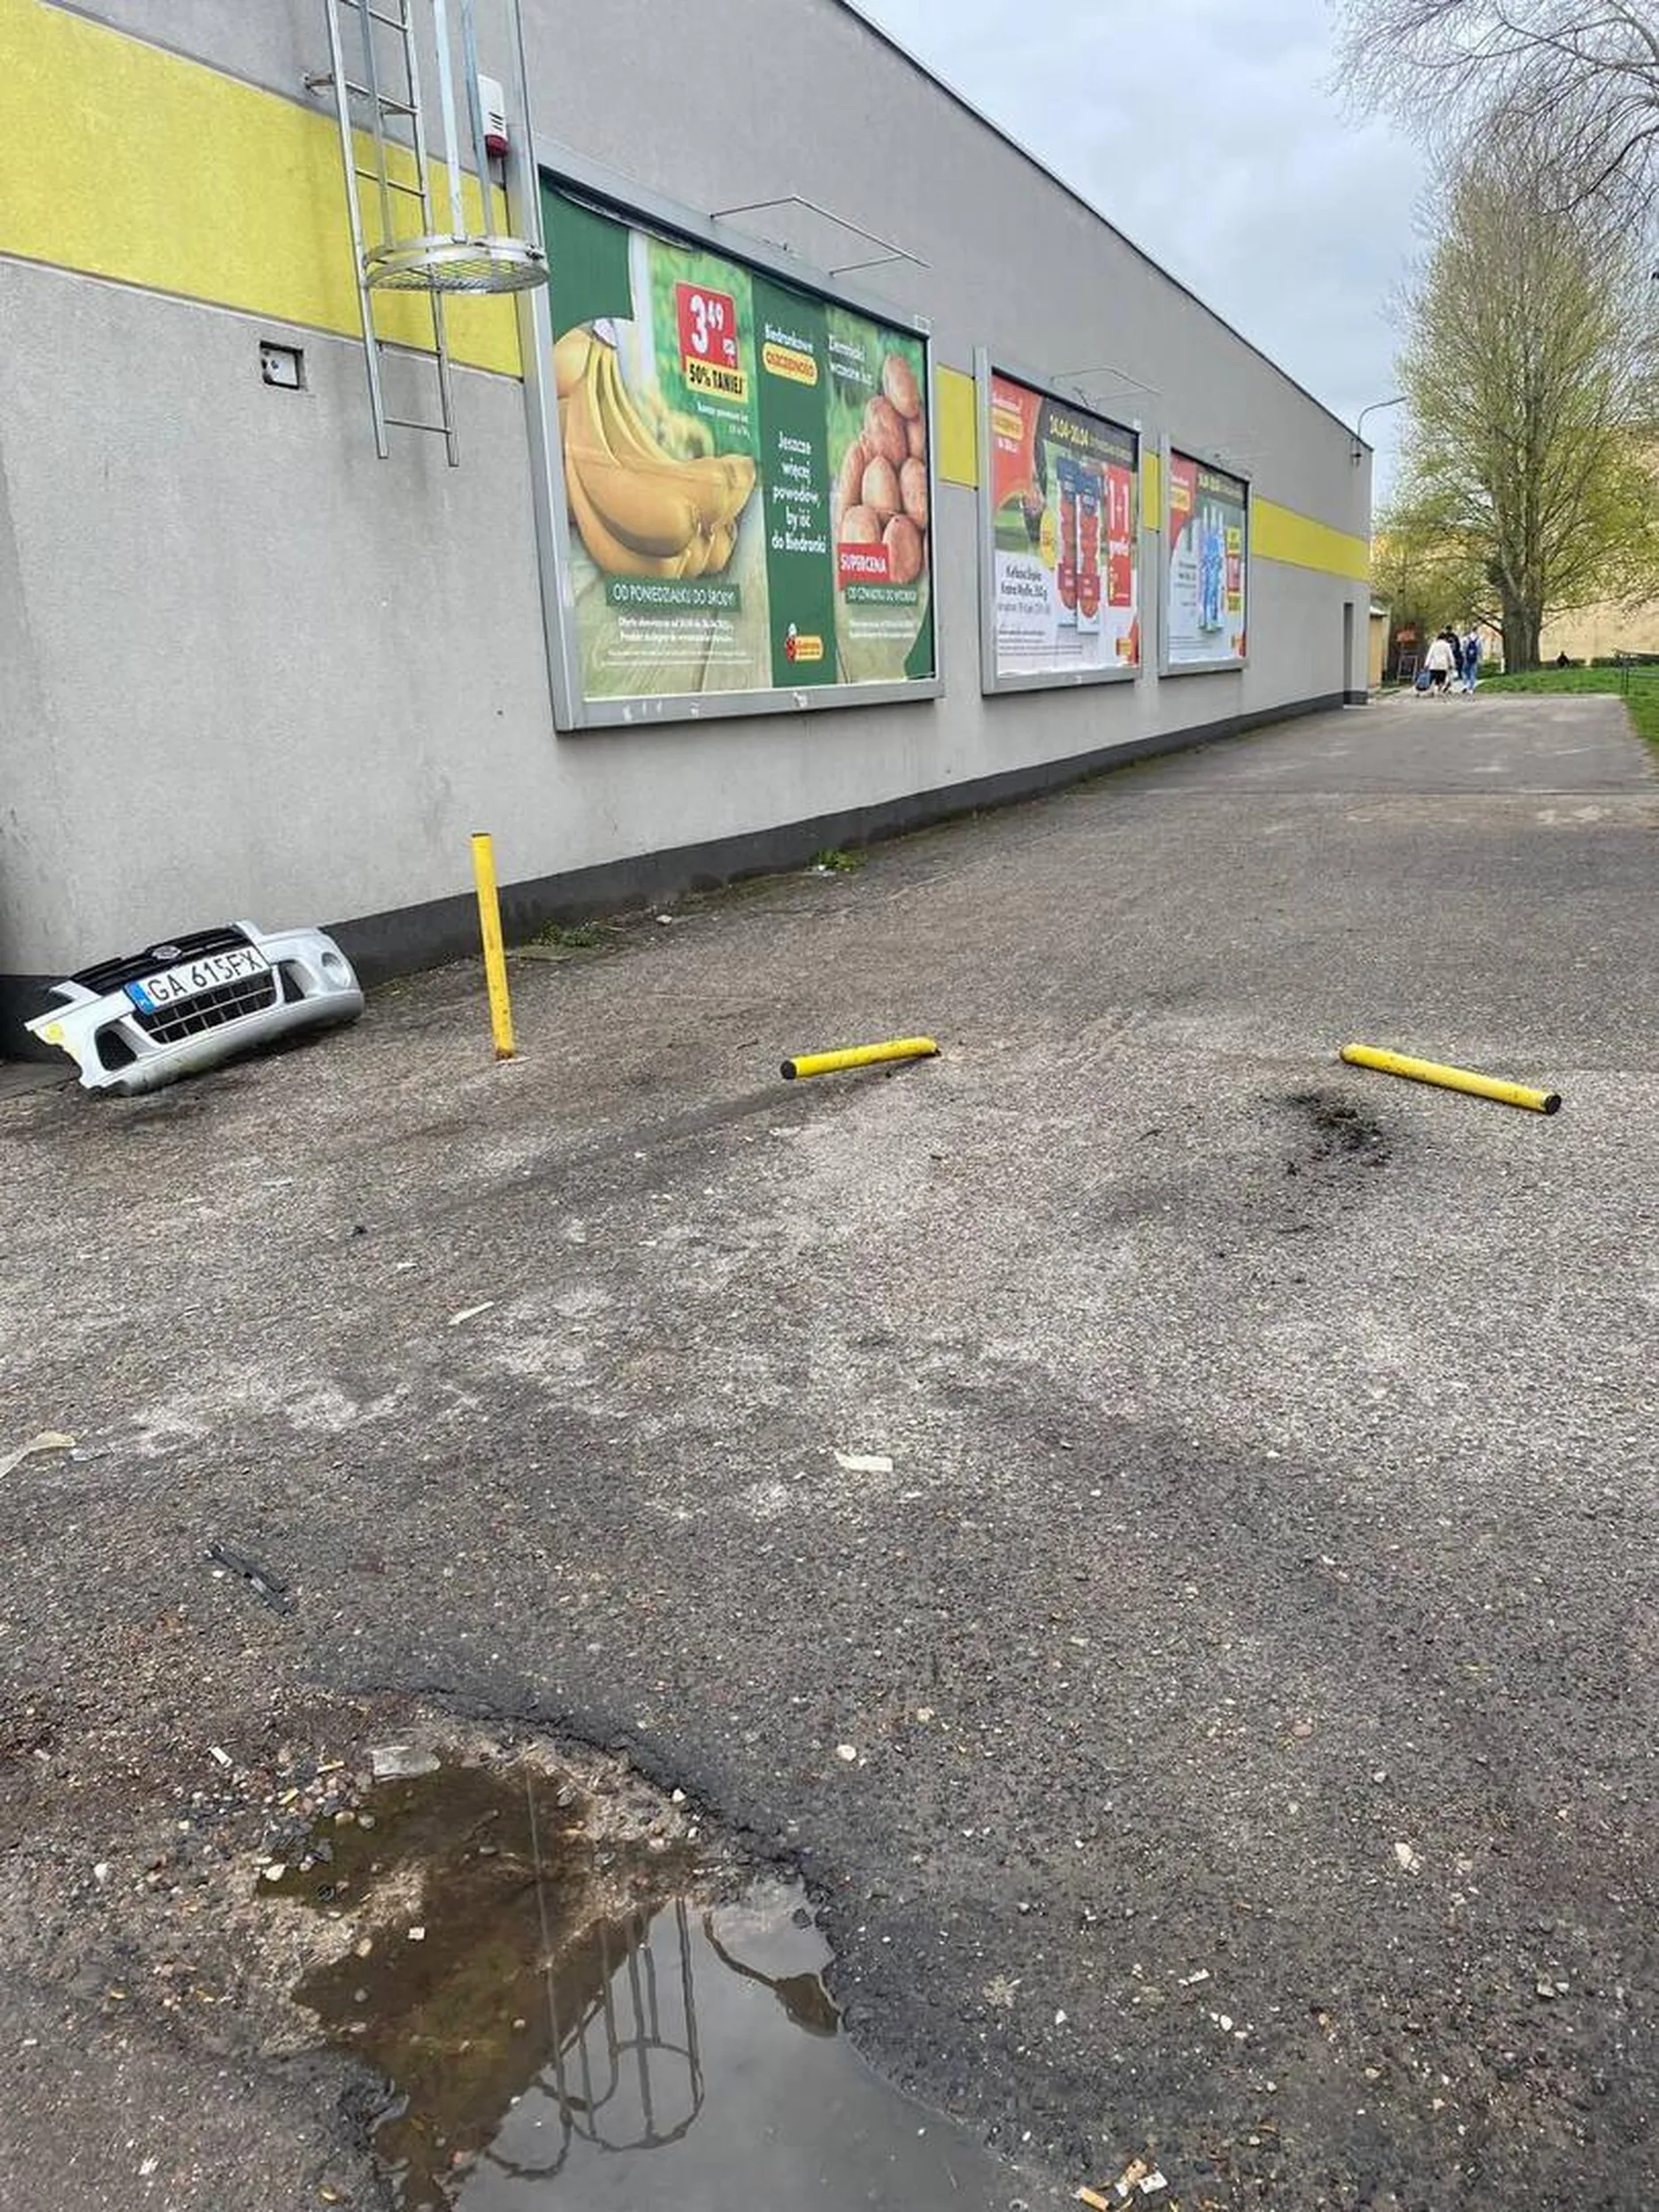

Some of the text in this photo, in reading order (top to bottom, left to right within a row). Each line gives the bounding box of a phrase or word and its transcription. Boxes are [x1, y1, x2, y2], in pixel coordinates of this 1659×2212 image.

[688, 364, 743, 396] 50% TANIEJ
[779, 431, 811, 455] Jeszcze
[781, 457, 811, 487] więcej
[772, 529, 826, 554] do Biedronki
[612, 583, 629, 601] OD
[693, 588, 706, 605] DO
[147, 949, 263, 1002] GA 615FX
